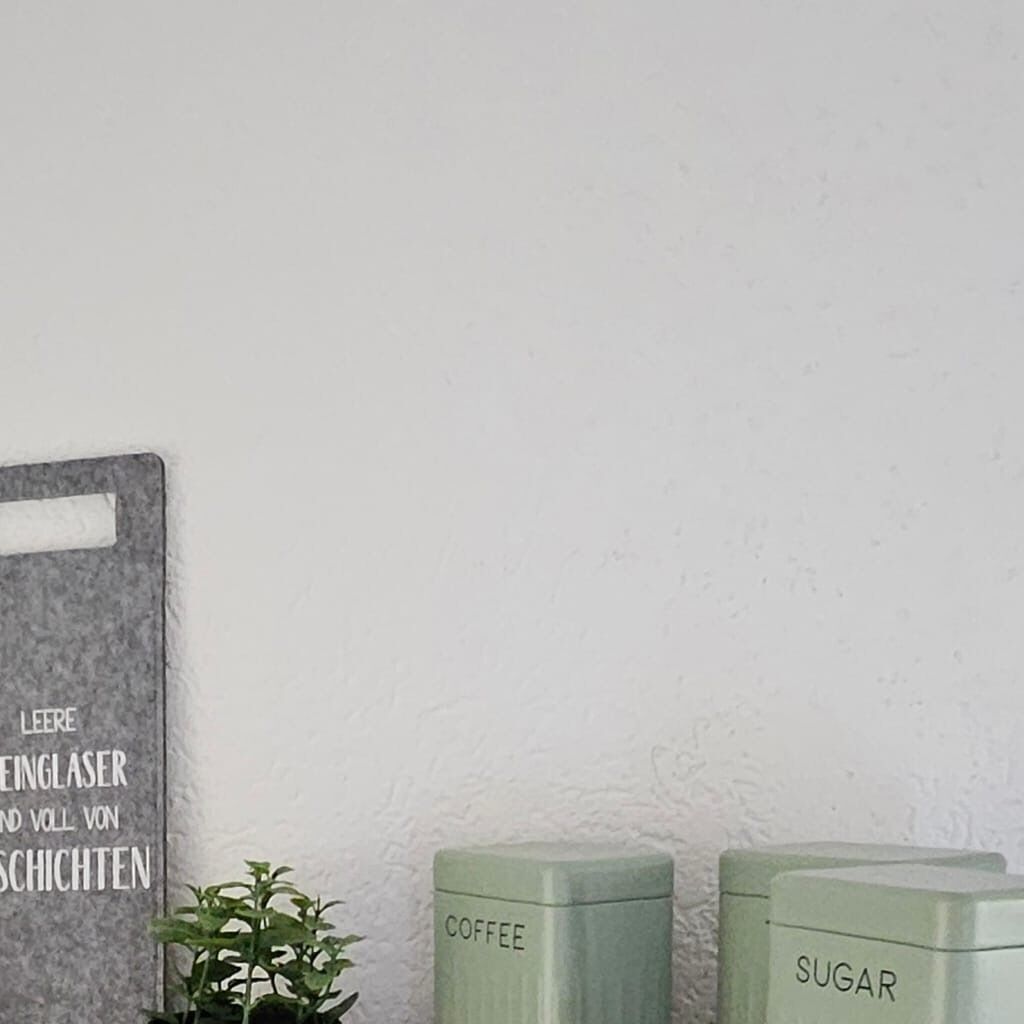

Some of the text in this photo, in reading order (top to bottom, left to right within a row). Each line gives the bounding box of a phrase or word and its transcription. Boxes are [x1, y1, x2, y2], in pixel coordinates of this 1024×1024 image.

[20, 707, 77, 735] LEERE
[30, 807, 75, 832] VOLL
[83, 805, 120, 831] VON
[445, 914, 526, 951] COFFEE
[796, 955, 896, 1002] SUGAR
